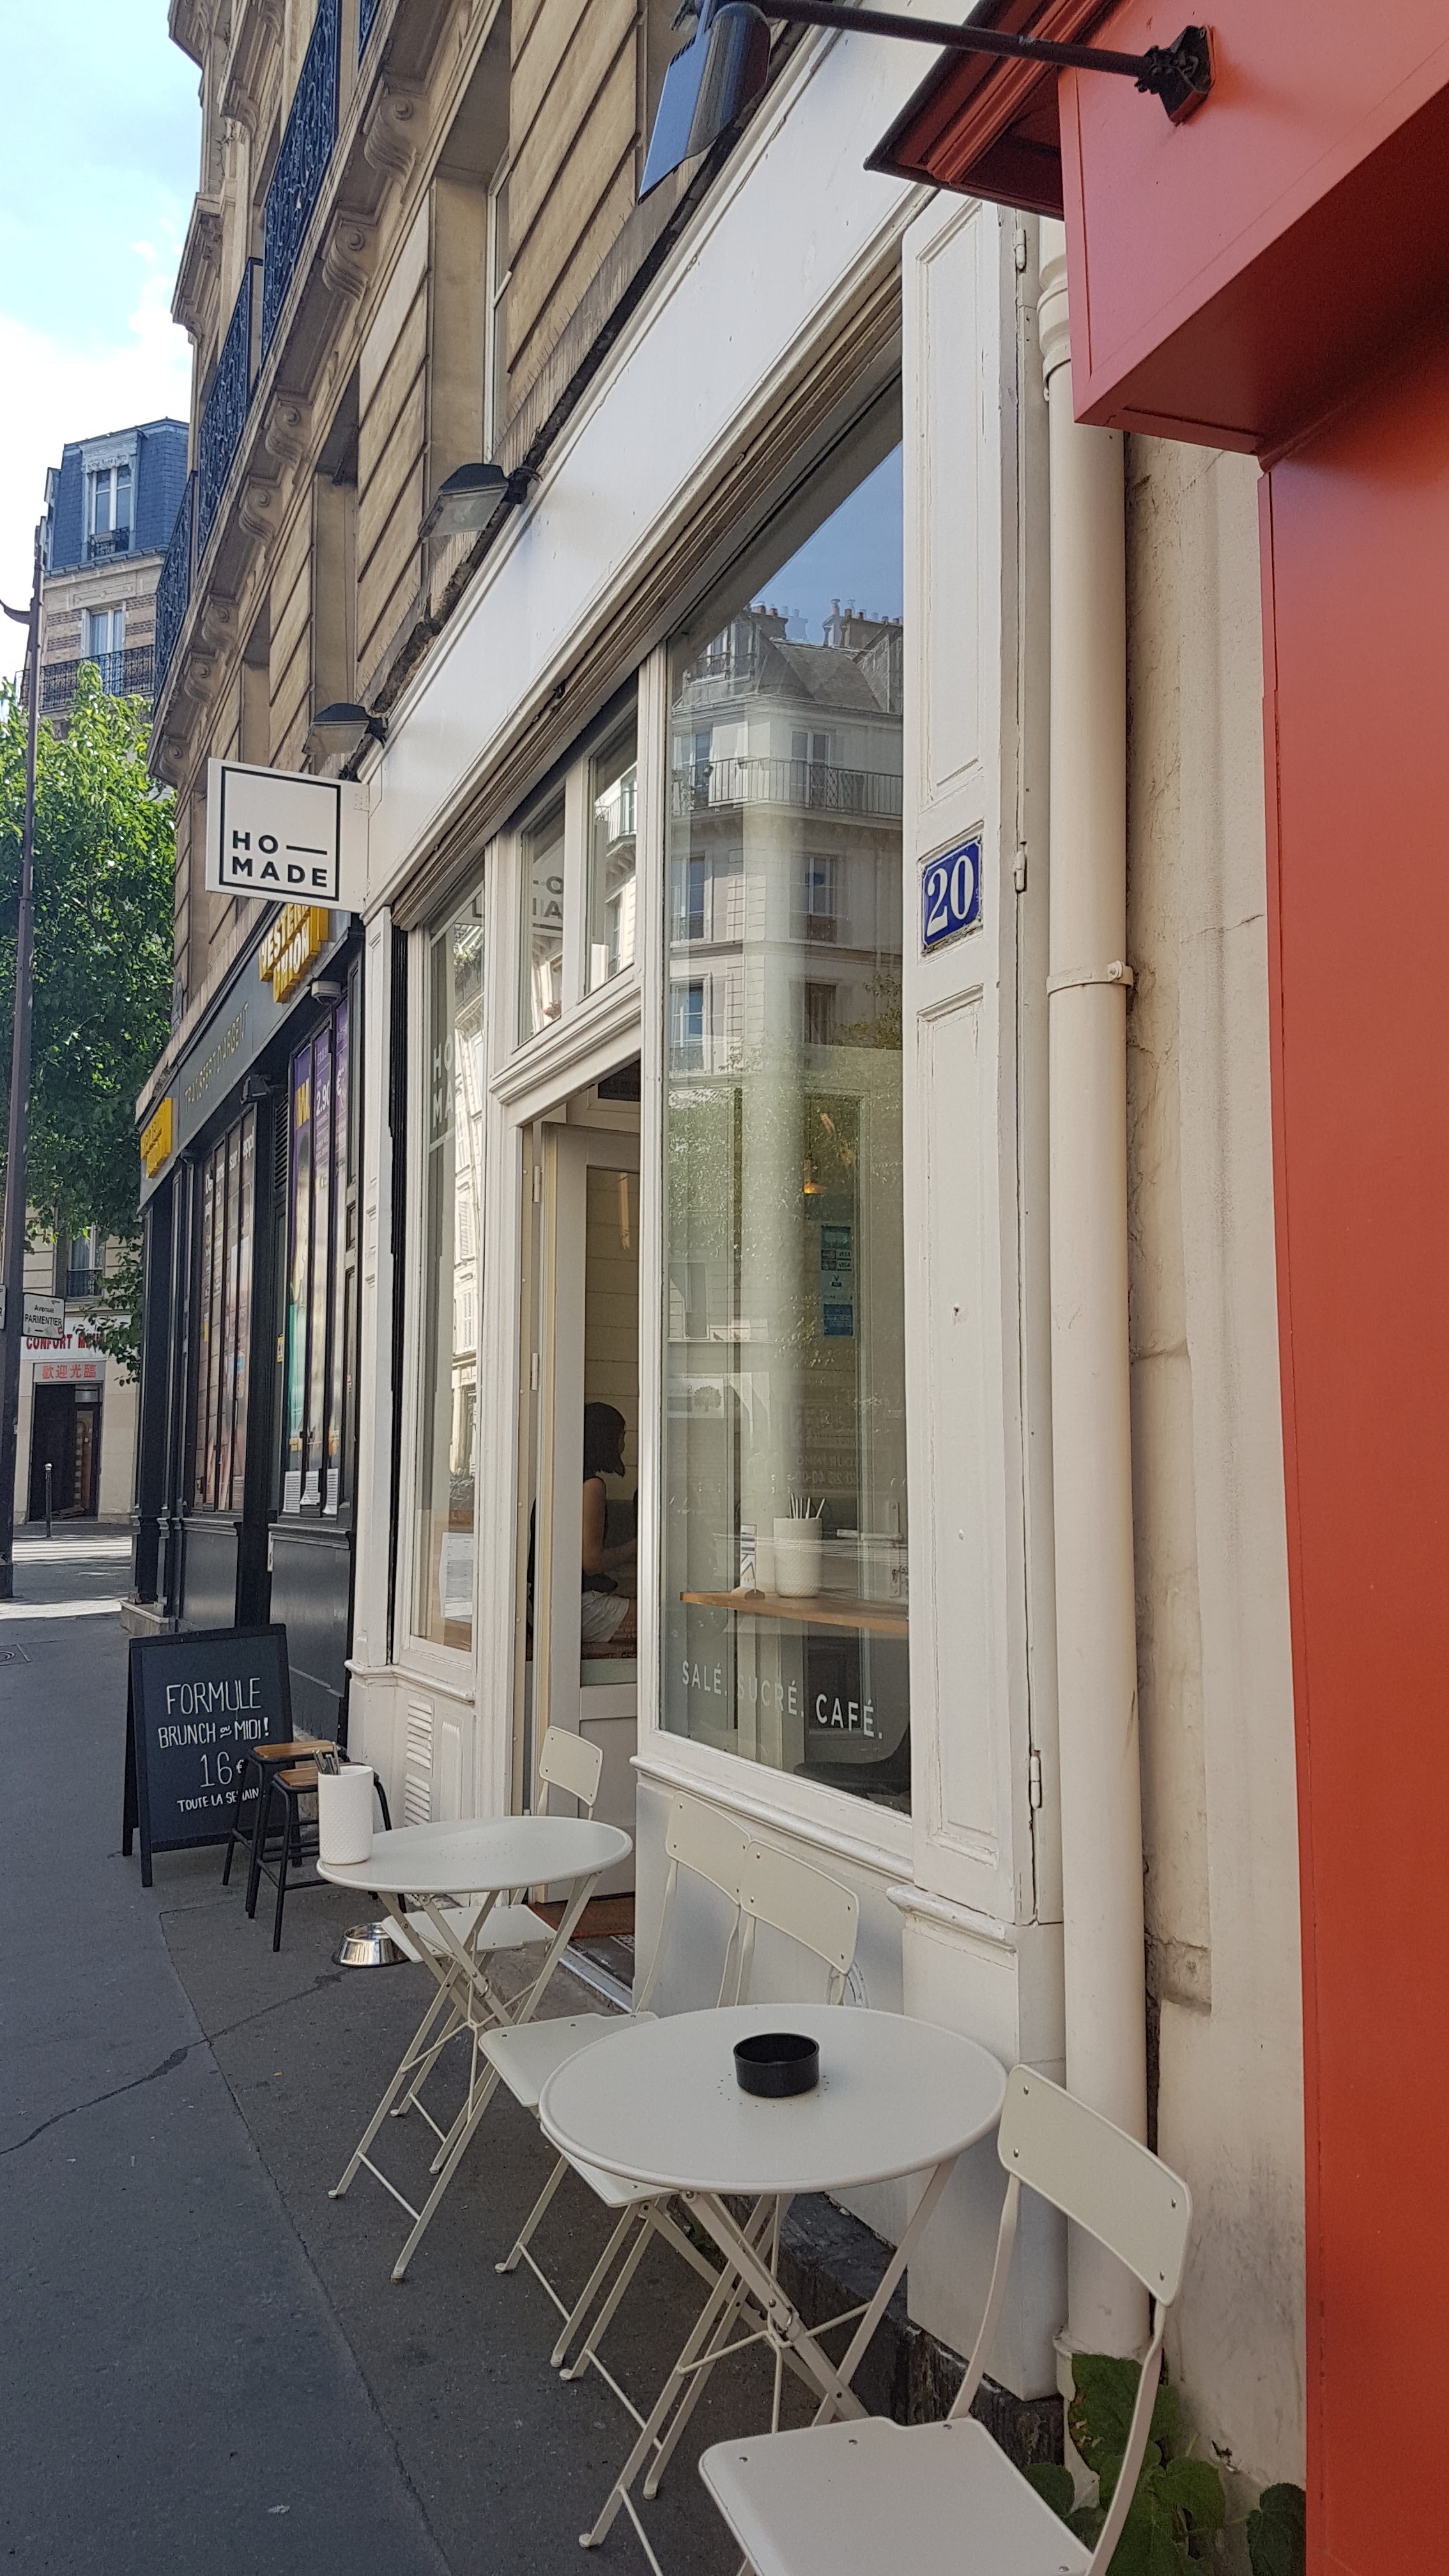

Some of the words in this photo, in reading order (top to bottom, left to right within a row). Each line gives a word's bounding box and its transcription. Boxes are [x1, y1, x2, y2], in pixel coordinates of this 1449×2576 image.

[232, 856, 328, 888] MADE
[927, 855, 974, 937] 20
[273, 916, 310, 1002] UNION
[25, 1314, 62, 1327] PARMENTIER
[26, 1333, 73, 1350] CONFORT
[42, 1363, 96, 1380] 歡迎光臨
[166, 1678, 262, 1715] FORMULE
[682, 1660, 728, 1697] SALÉ.
[737, 1674, 804, 1717] SUCRÉ.
[815, 1692, 883, 1740] CAFÉ.
[158, 1722, 217, 1749] BRUNCH
[177, 1796, 209, 1813] TOUTE
[211, 1794, 223, 1806] LA
